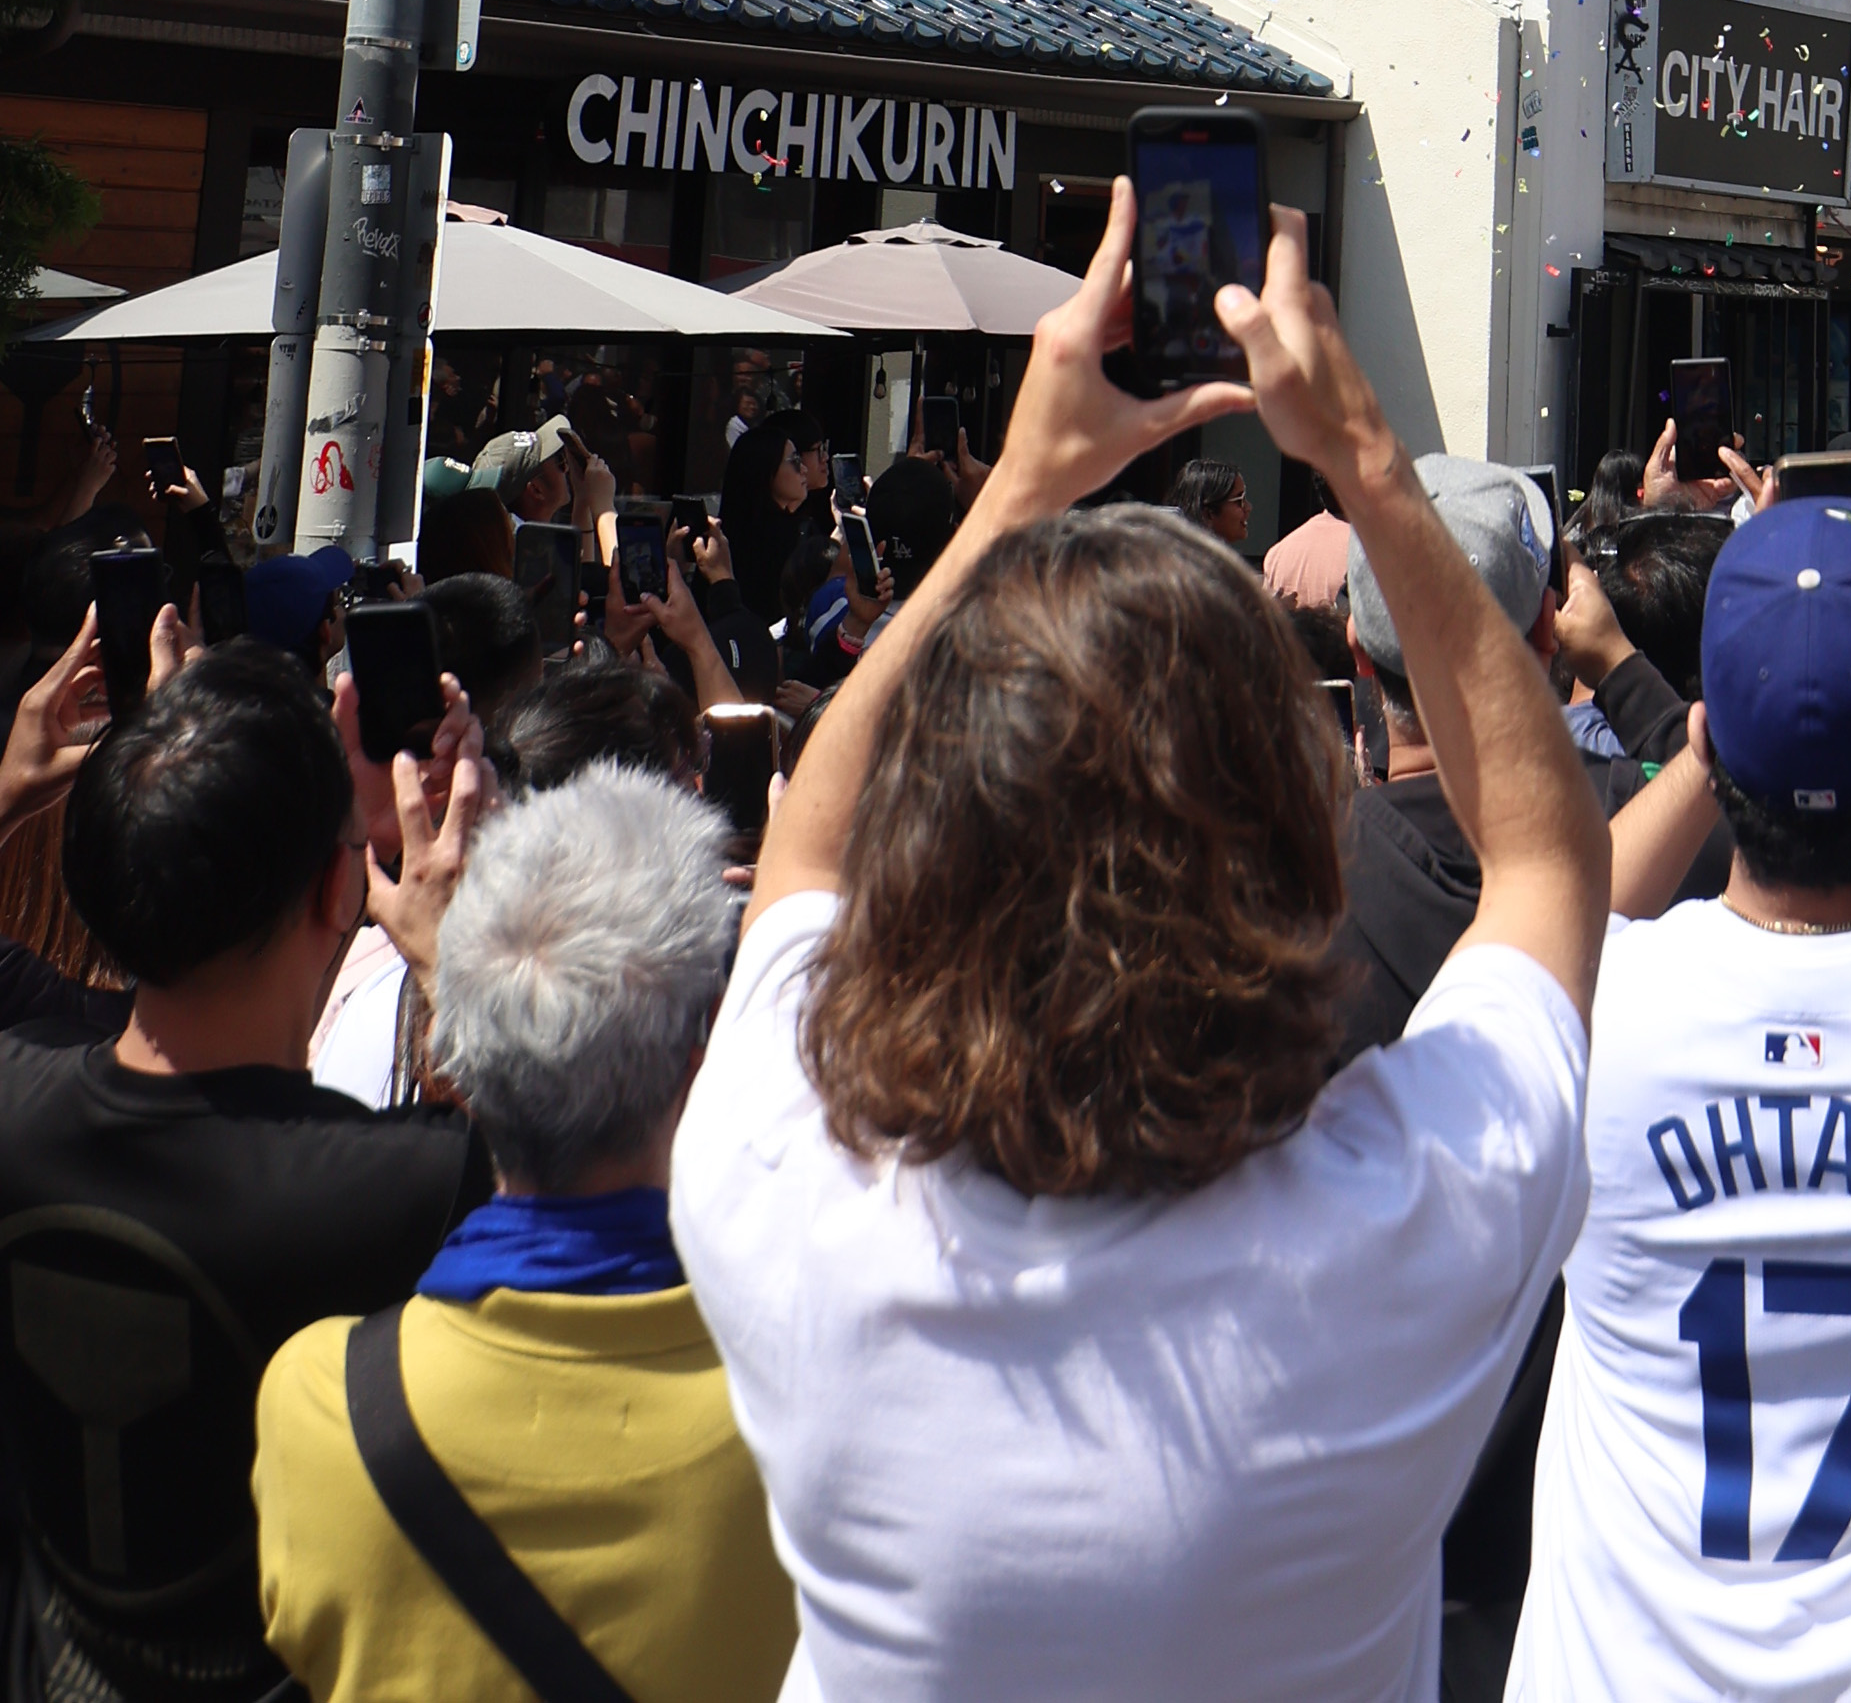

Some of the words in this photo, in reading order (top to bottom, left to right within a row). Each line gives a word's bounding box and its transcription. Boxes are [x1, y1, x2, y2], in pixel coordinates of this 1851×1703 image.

[567, 73, 1017, 191] CHINCHIKURIN
[1661, 49, 1753, 129] CITY
[1757, 65, 1845, 142] HAIR
